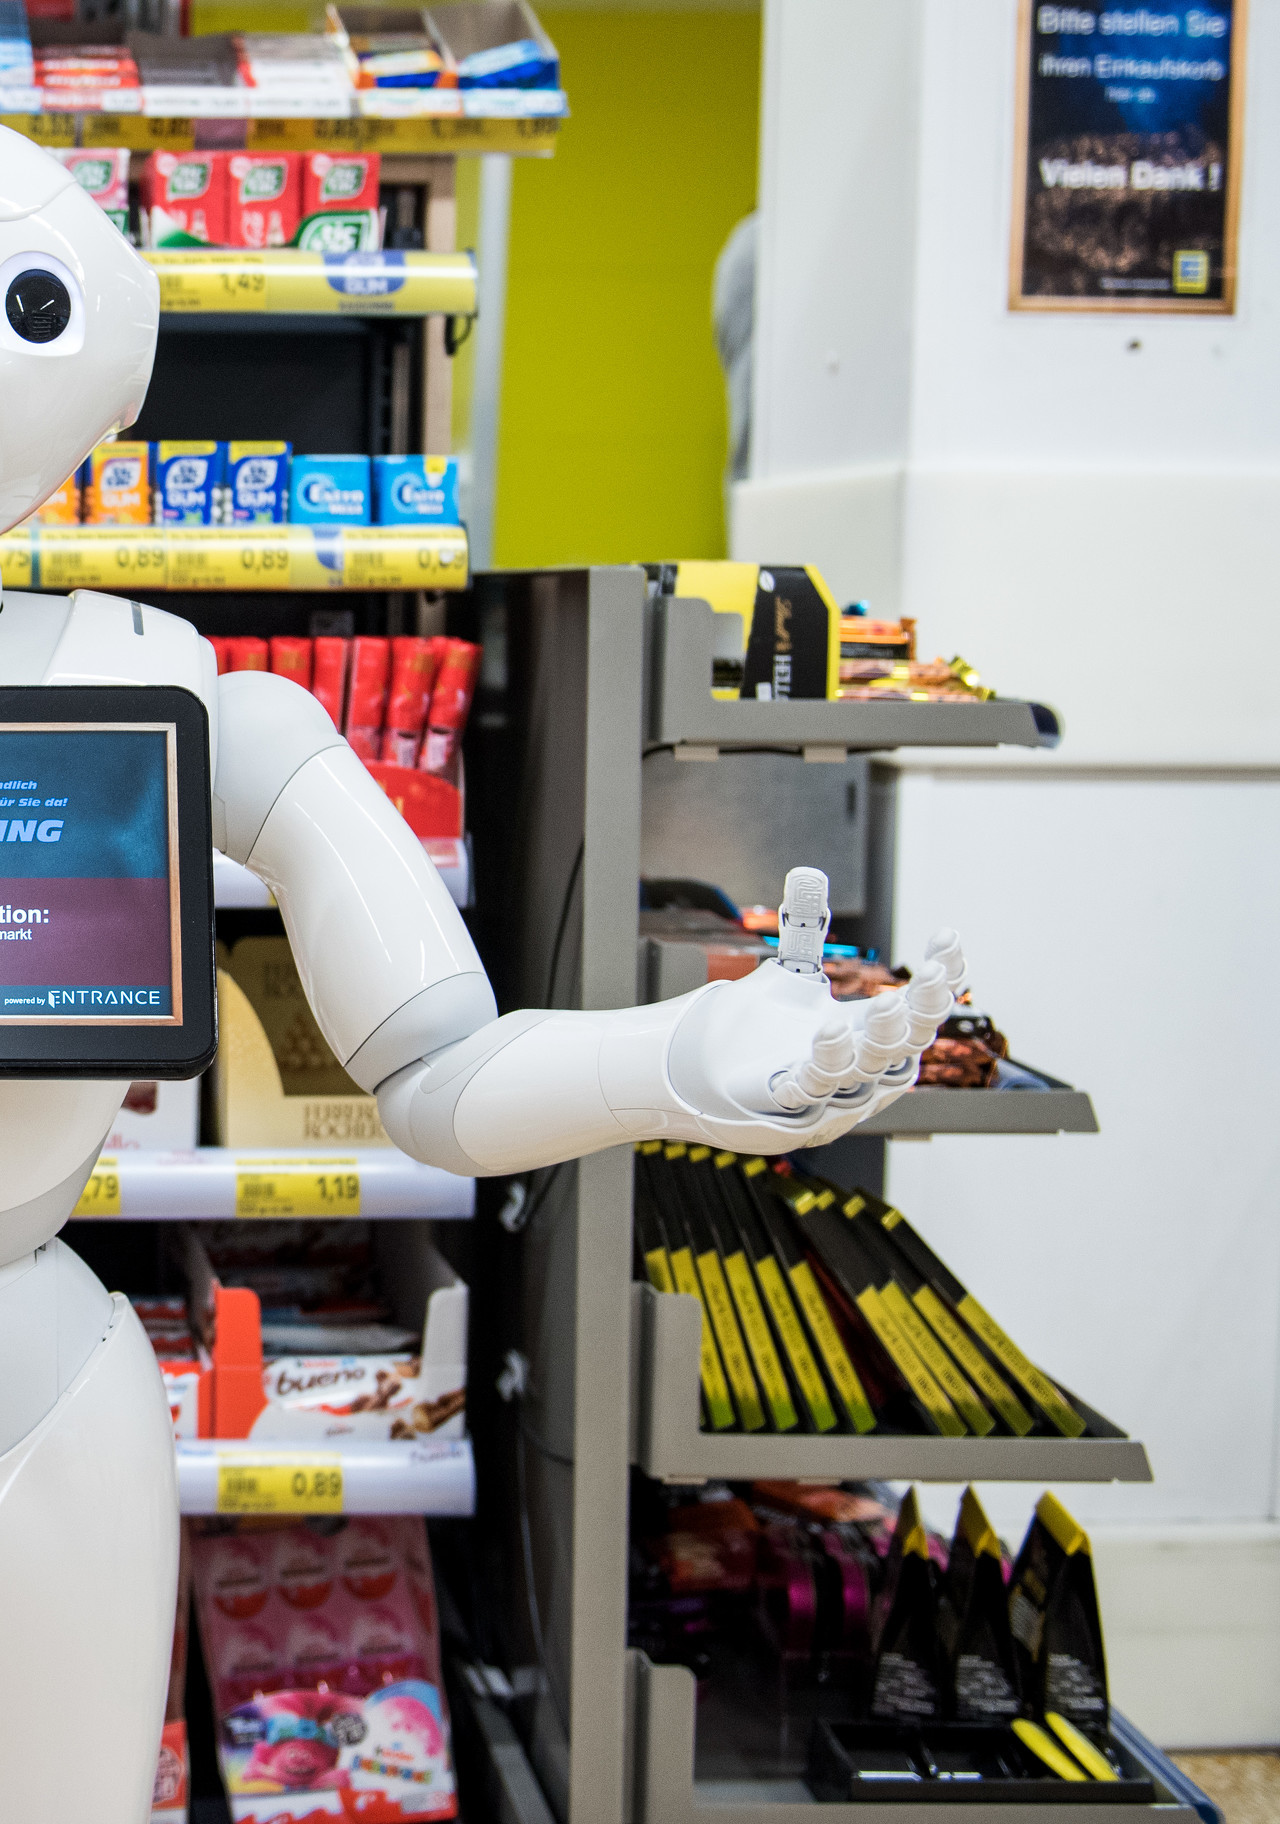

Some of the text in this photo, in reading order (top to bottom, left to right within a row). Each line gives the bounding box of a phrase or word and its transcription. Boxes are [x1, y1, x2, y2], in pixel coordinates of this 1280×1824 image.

[1039, 158, 1126, 189] Vielen
[1130, 160, 1204, 191] Dank
[116, 546, 164, 572] 0,89
[241, 547, 289, 573] 0,89
[18, 797, 41, 807] Sie
[44, 797, 68, 807] da!
[4, 990, 161, 1008] powered by ENTRANCE
[276, 1367, 367, 1396] bueno
[291, 1470, 342, 1499] 0,89
